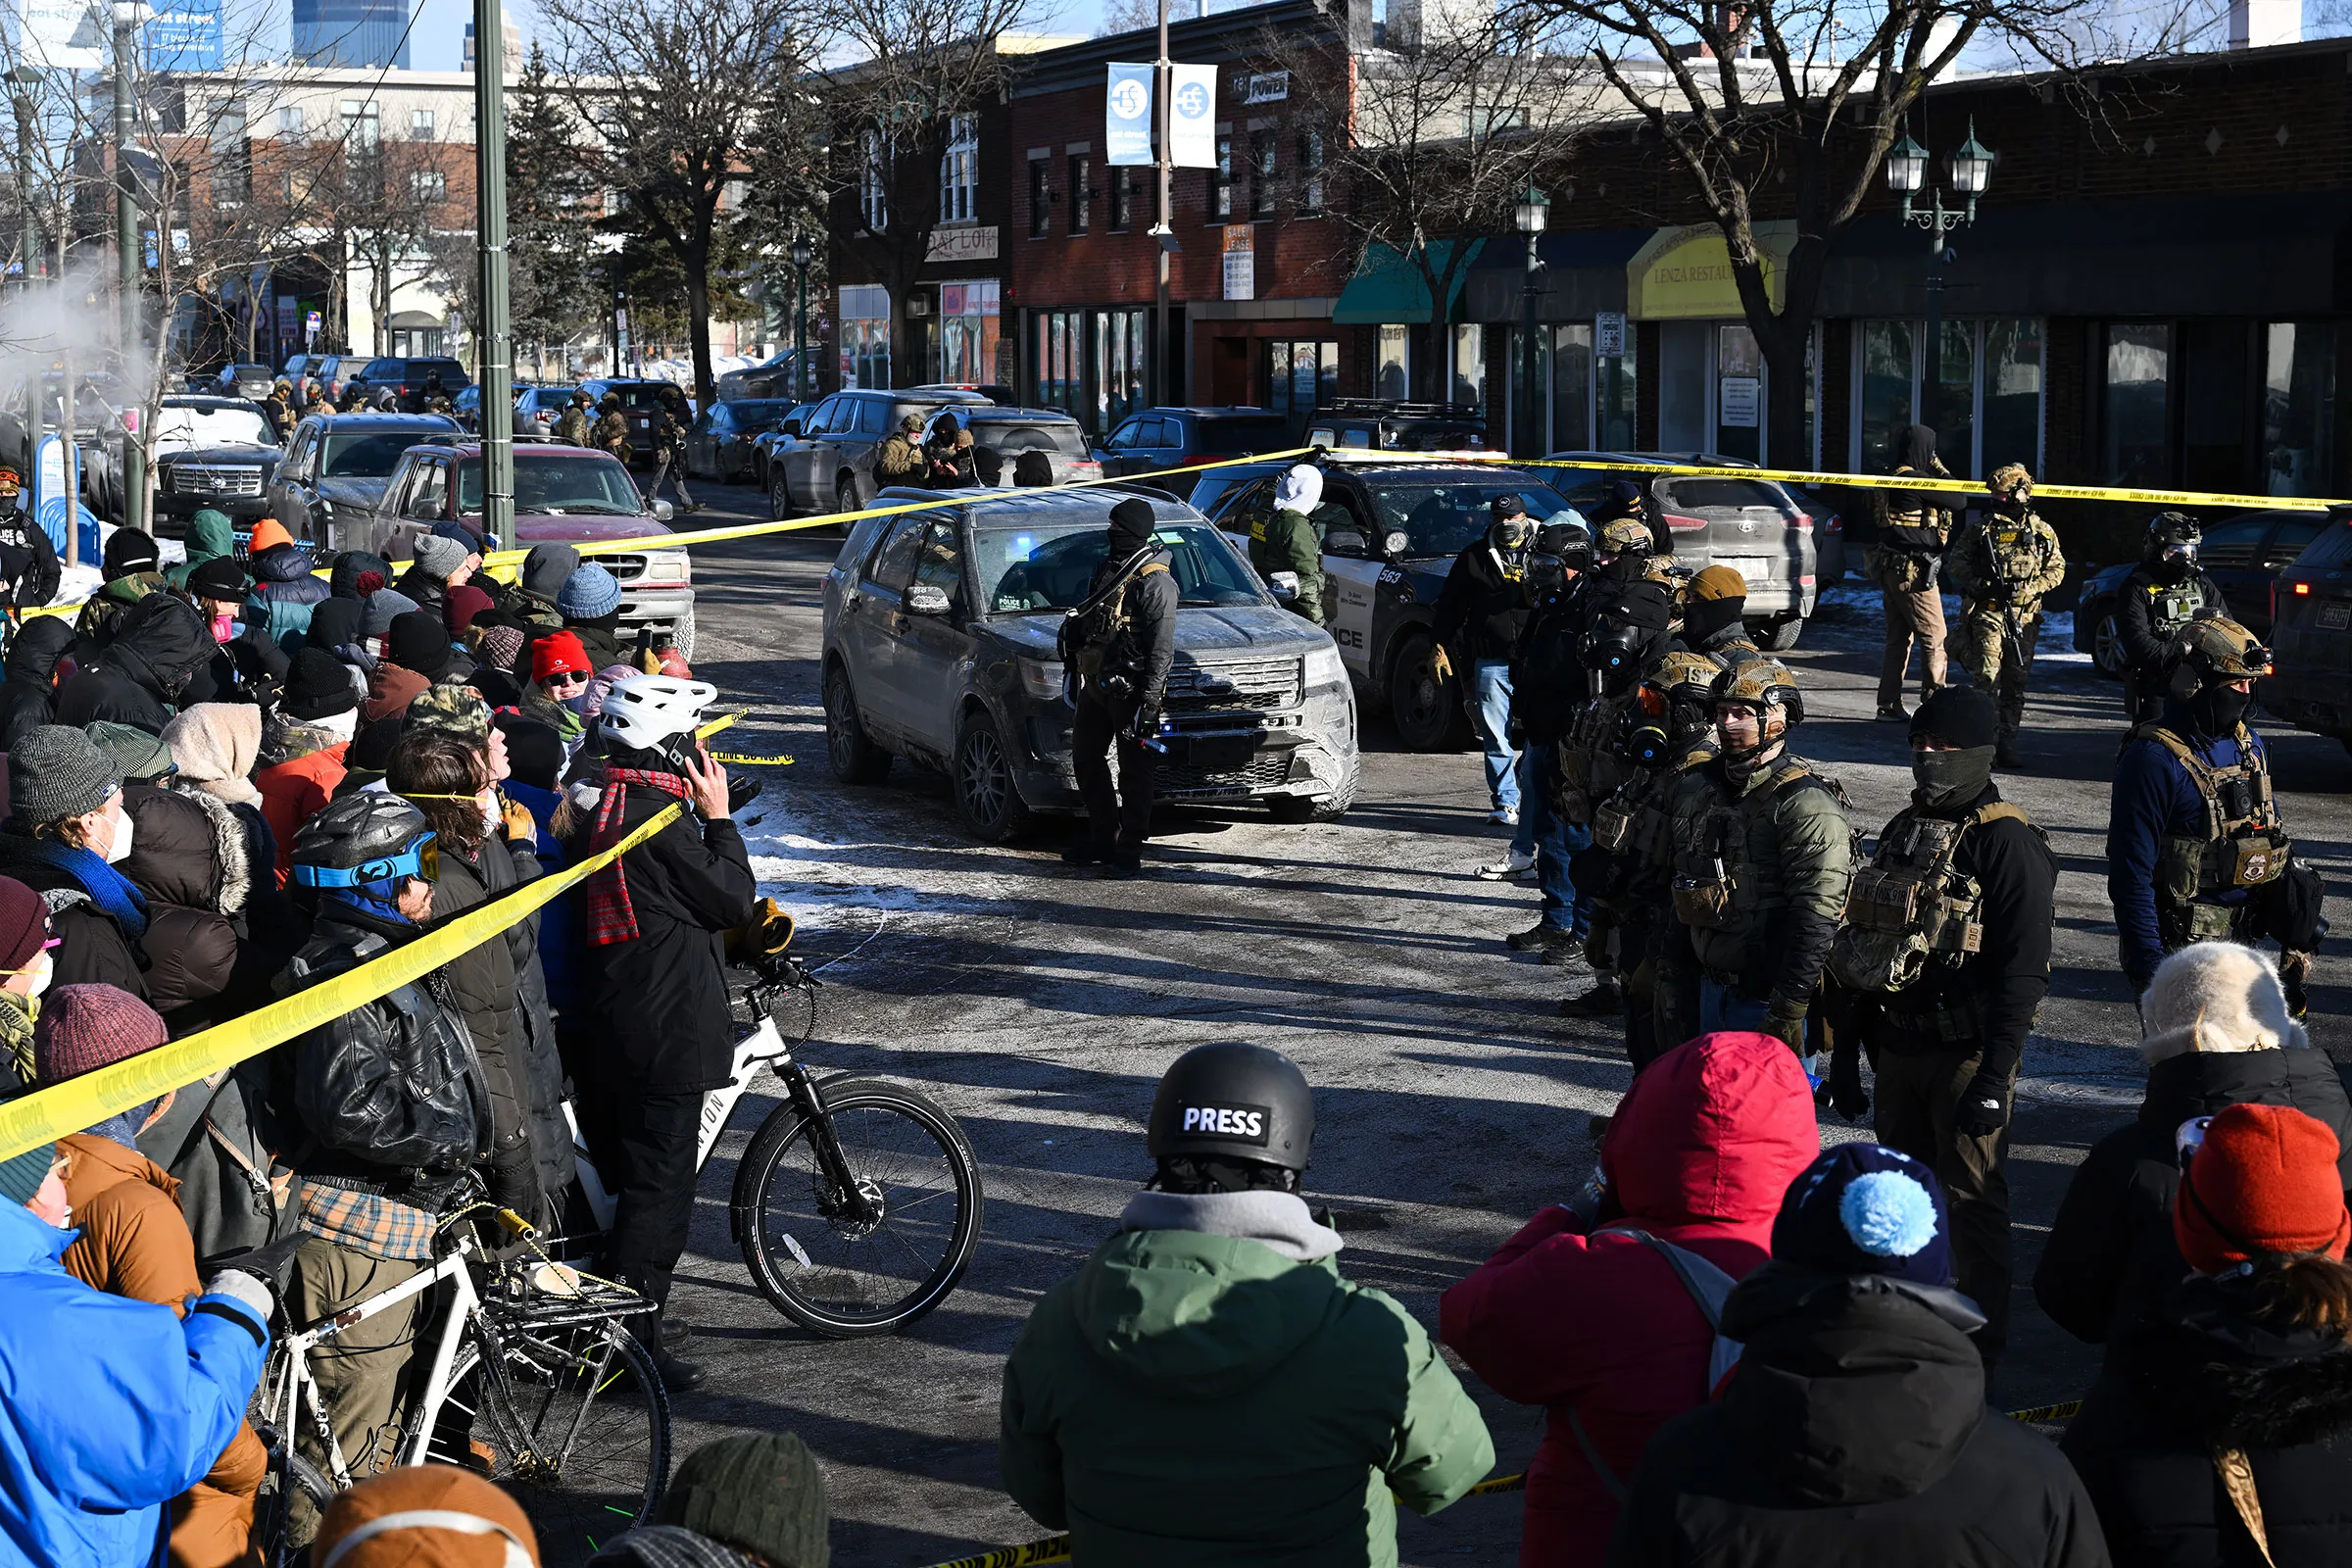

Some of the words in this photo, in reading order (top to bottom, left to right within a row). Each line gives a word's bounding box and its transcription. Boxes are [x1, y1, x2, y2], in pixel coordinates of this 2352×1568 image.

[1251, 79, 1286, 96] POWER
[1227, 239, 1250, 251] LEASE
[1654, 268, 1688, 284] LENZA
[1690, 265, 1735, 282] RESTAU
[0, 529, 15, 541] LICE
[1379, 569, 1402, 585] 563
[999, 598, 1020, 607] POLICE
[1333, 627, 1363, 650] ICE
[1183, 1107, 1262, 1137] PRESS
